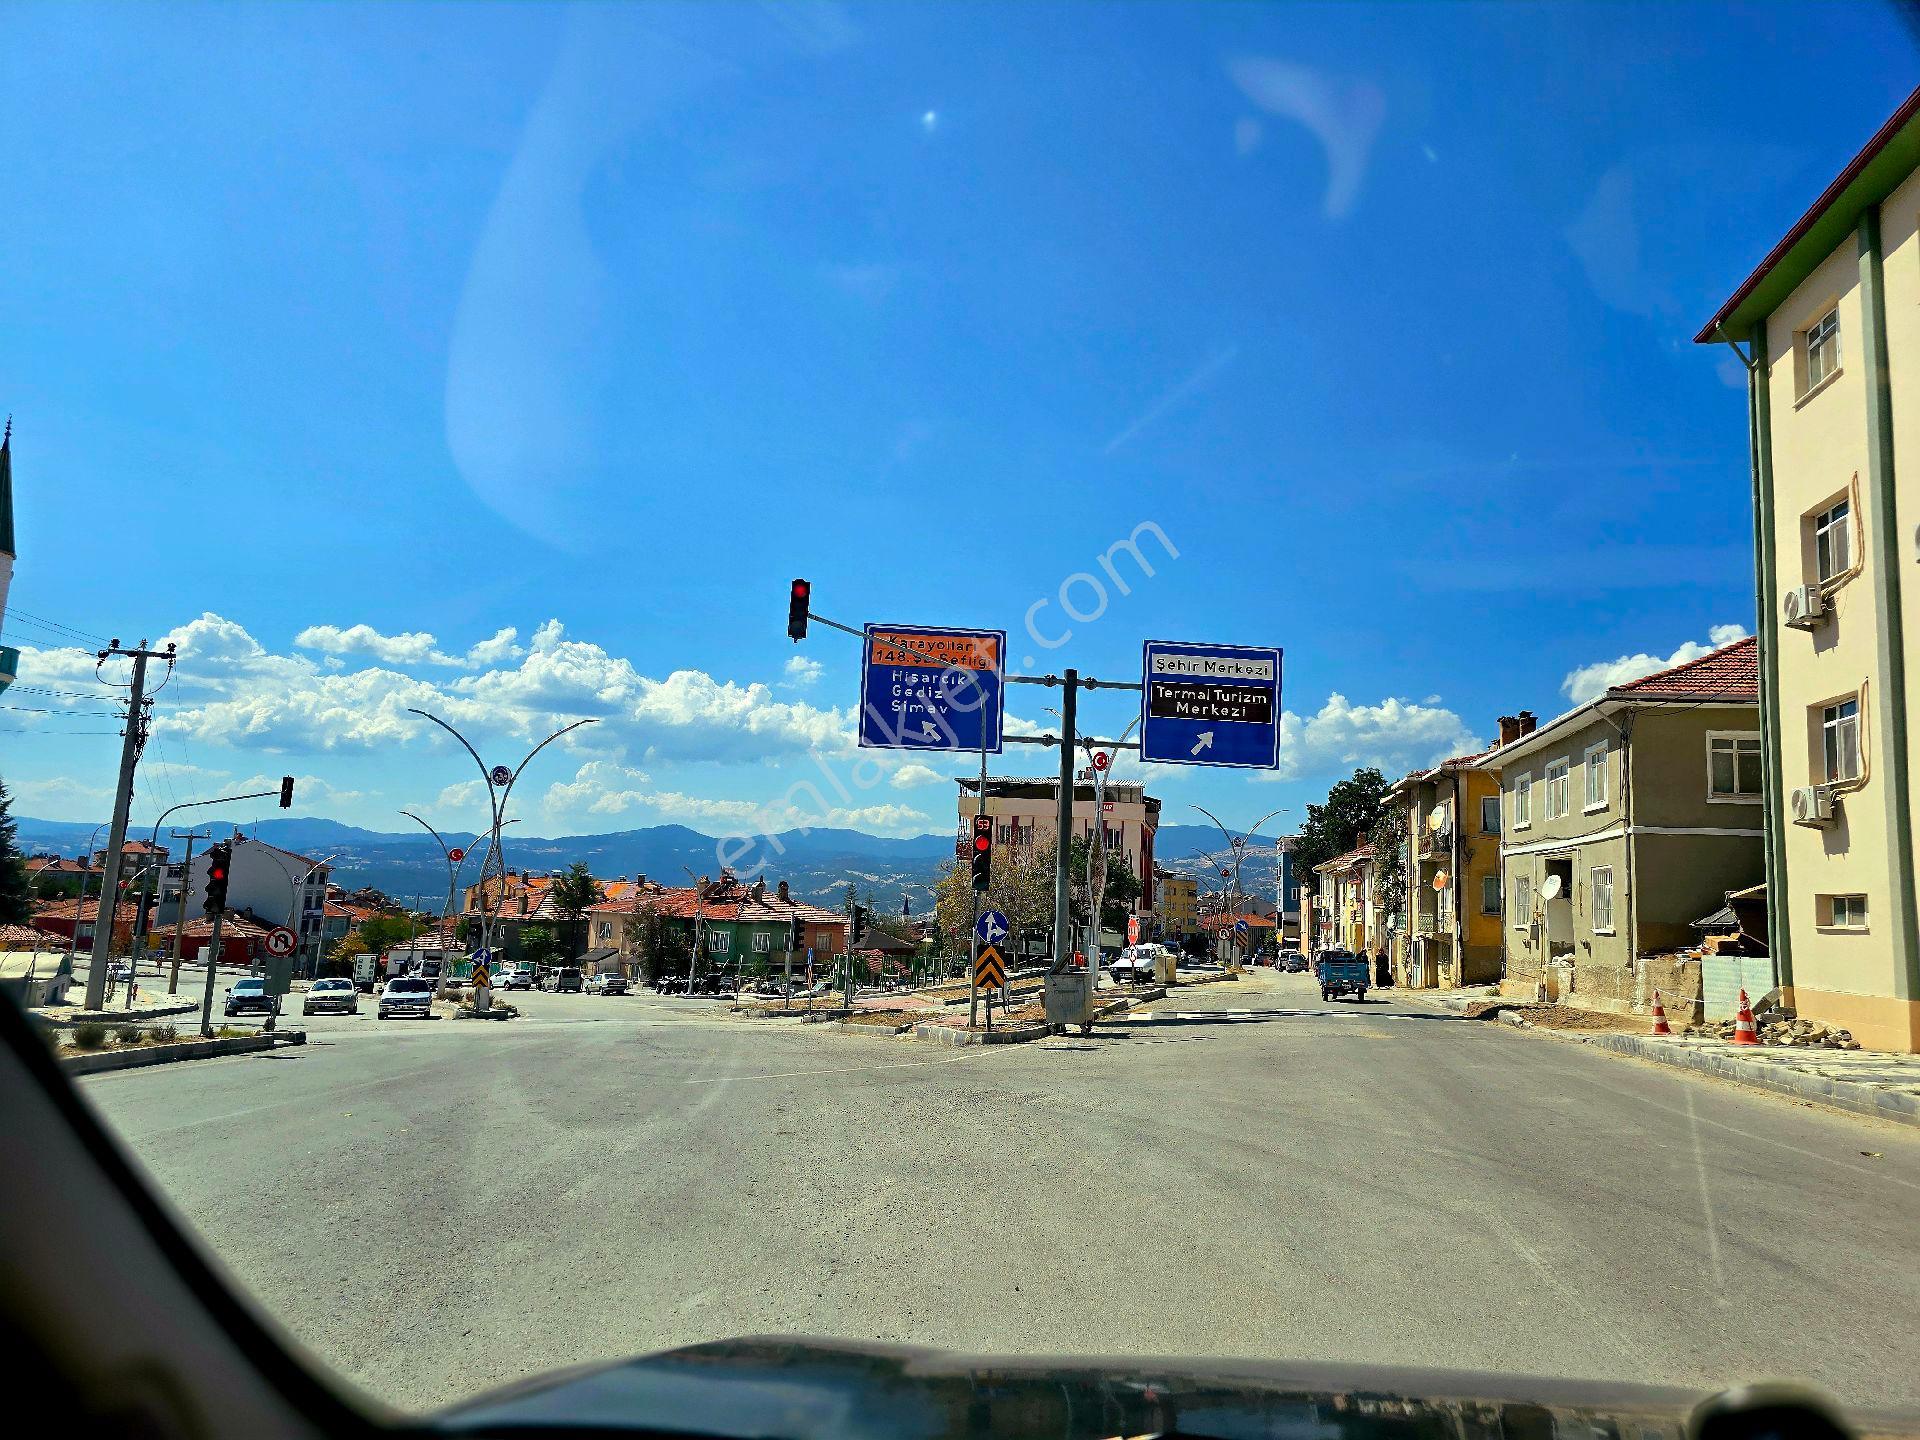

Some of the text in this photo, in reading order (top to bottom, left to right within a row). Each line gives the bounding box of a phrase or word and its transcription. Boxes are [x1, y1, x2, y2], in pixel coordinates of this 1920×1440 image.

[1156, 658, 1269, 676] Şehir Merkezi
[892, 669, 966, 685] Hisarcık
[892, 684, 943, 699] Gediz
[1156, 685, 1267, 704] Termal Turizm
[891, 699, 949, 714] Simav
[1176, 701, 1247, 717] Merkezi
